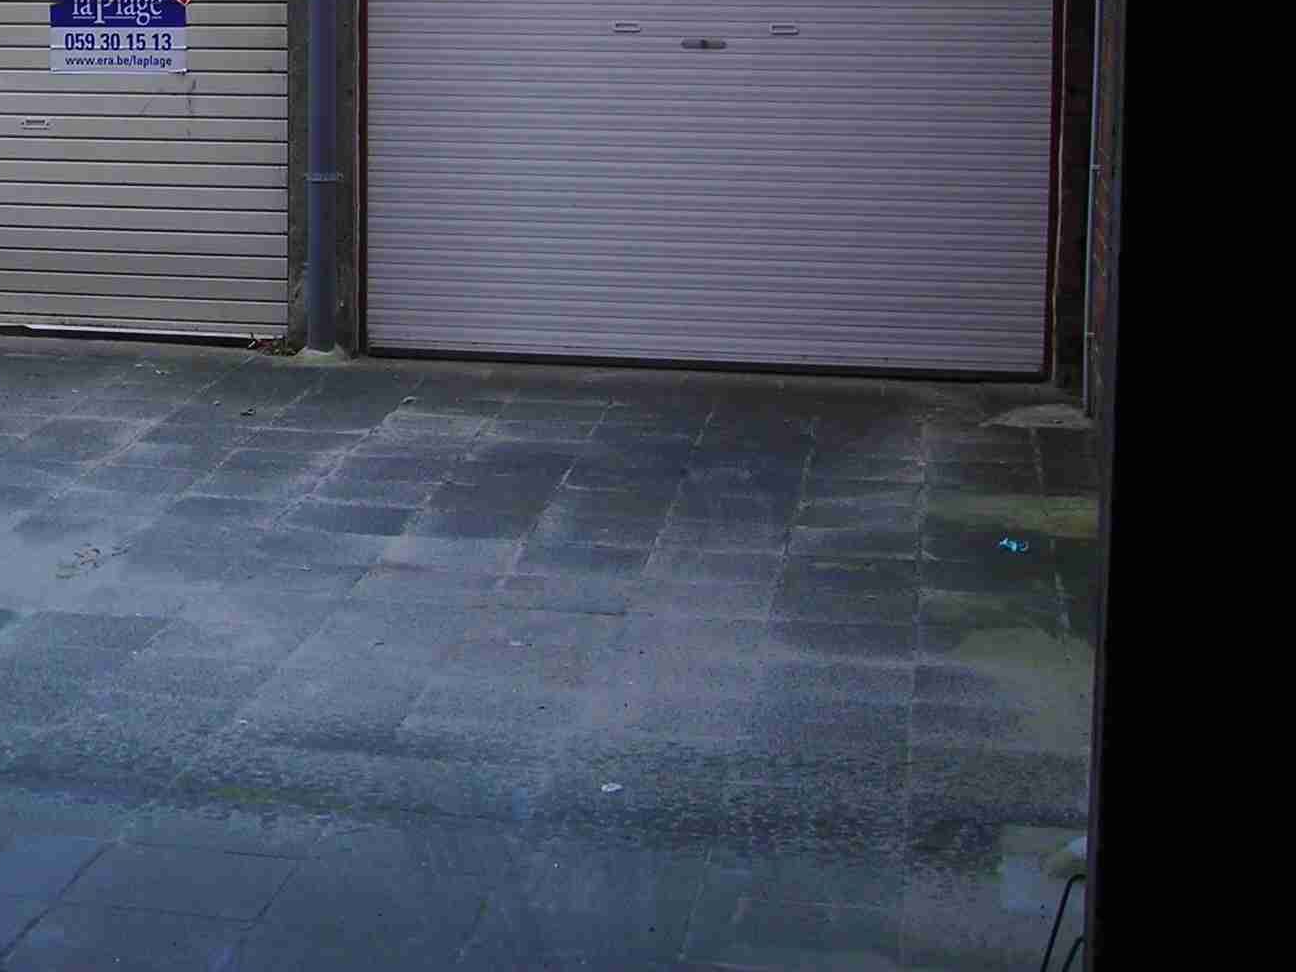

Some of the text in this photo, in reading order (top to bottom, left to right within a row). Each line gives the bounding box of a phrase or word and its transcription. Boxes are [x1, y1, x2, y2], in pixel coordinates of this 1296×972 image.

[64, 32, 172, 51] 059 30 15 13
[64, 54, 173, 69] www.era.be/laplage
